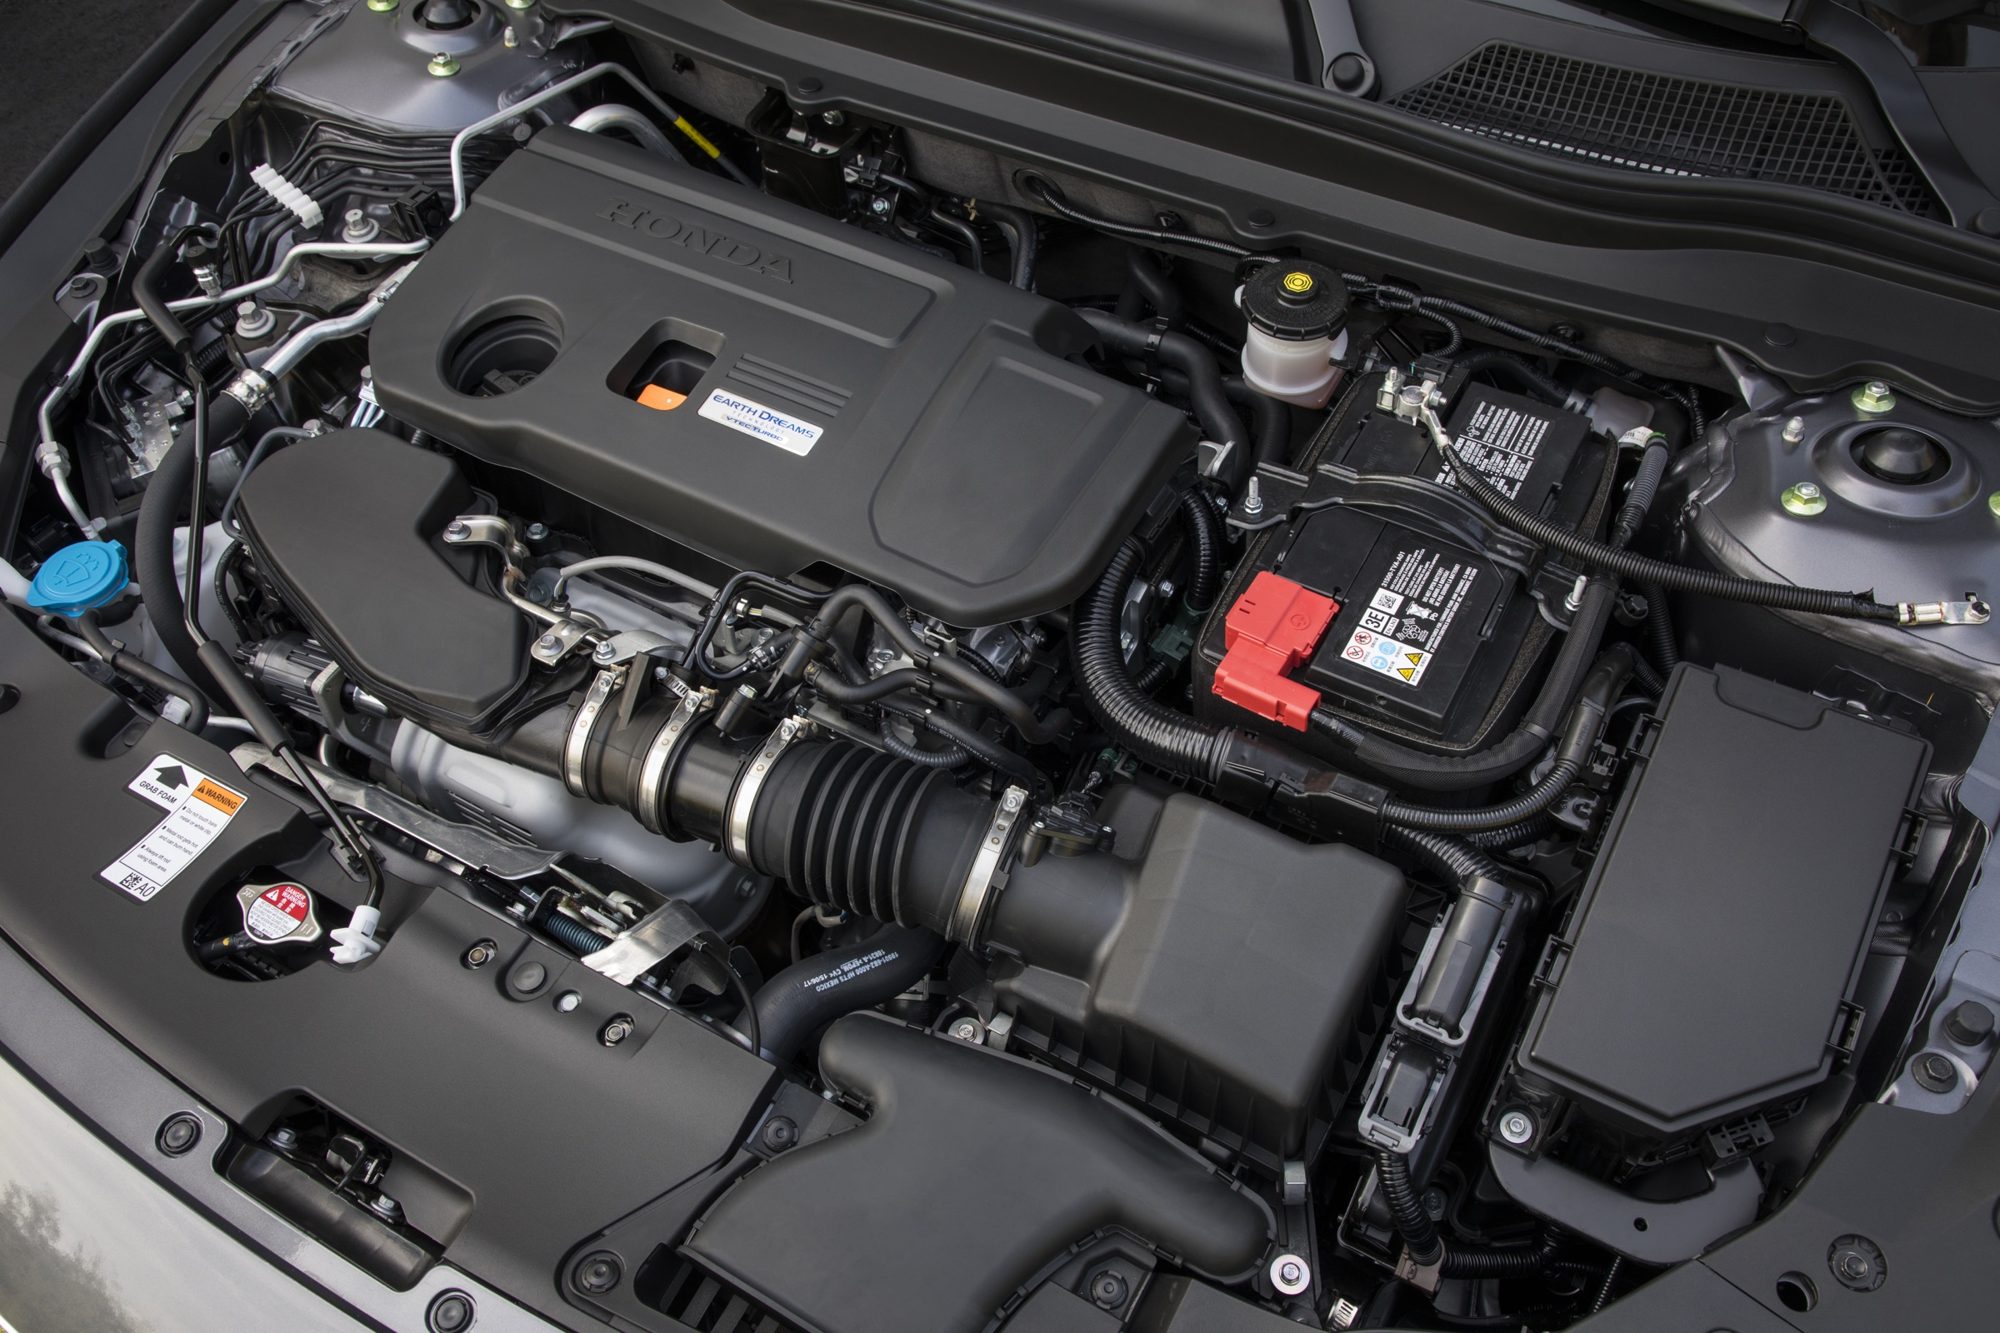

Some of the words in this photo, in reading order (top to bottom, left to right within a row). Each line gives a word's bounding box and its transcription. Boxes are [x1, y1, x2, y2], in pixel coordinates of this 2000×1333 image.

[596, 198, 795, 285] HONDA
[713, 395, 758, 416] EARTH
[758, 411, 815, 438] DREAMS
[1365, 612, 1384, 628] 3E
[139, 780, 160, 797] GRAB
[158, 789, 178, 804] FOAM
[204, 788, 238, 810] WARNING
